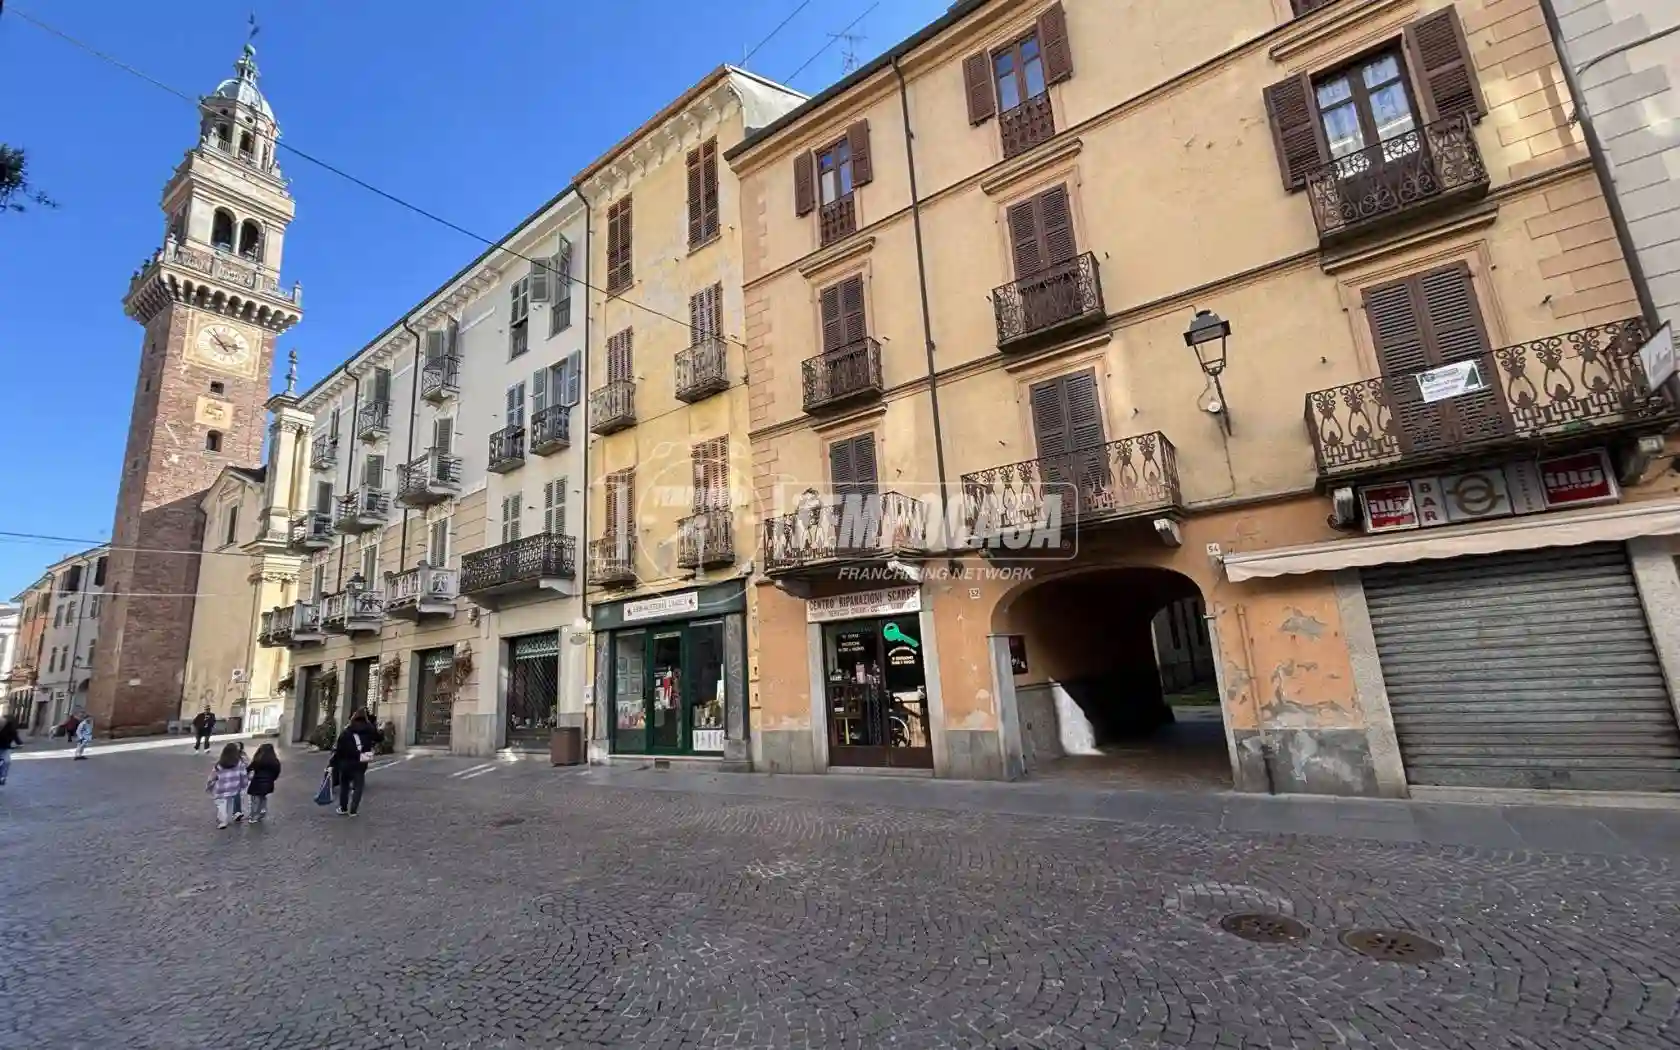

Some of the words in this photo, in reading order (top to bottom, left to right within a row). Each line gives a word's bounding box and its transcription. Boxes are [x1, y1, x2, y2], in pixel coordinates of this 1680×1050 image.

[1418, 483, 1438, 521] BAR
[808, 598, 835, 611] CENTRO
[839, 591, 883, 607] RIPARAZIONI
